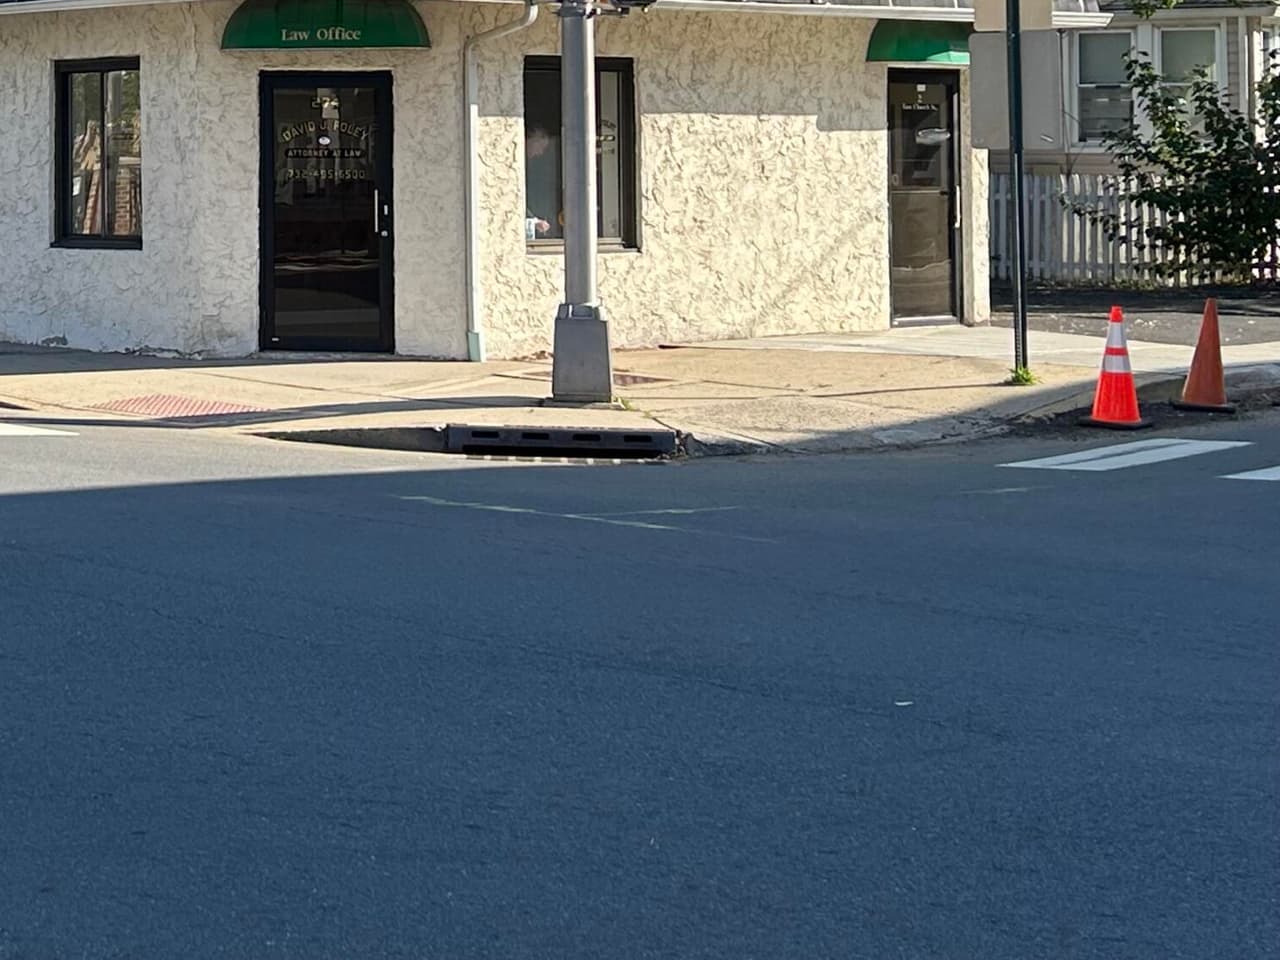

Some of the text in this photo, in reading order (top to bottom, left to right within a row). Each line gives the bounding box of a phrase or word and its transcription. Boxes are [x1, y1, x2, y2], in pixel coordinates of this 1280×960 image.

[281, 27, 361, 41] Law Office
[282, 121, 316, 141] DAVID
[333, 120, 369, 141] FOLEY
[288, 149, 362, 157] ATTORNEY AT LAW
